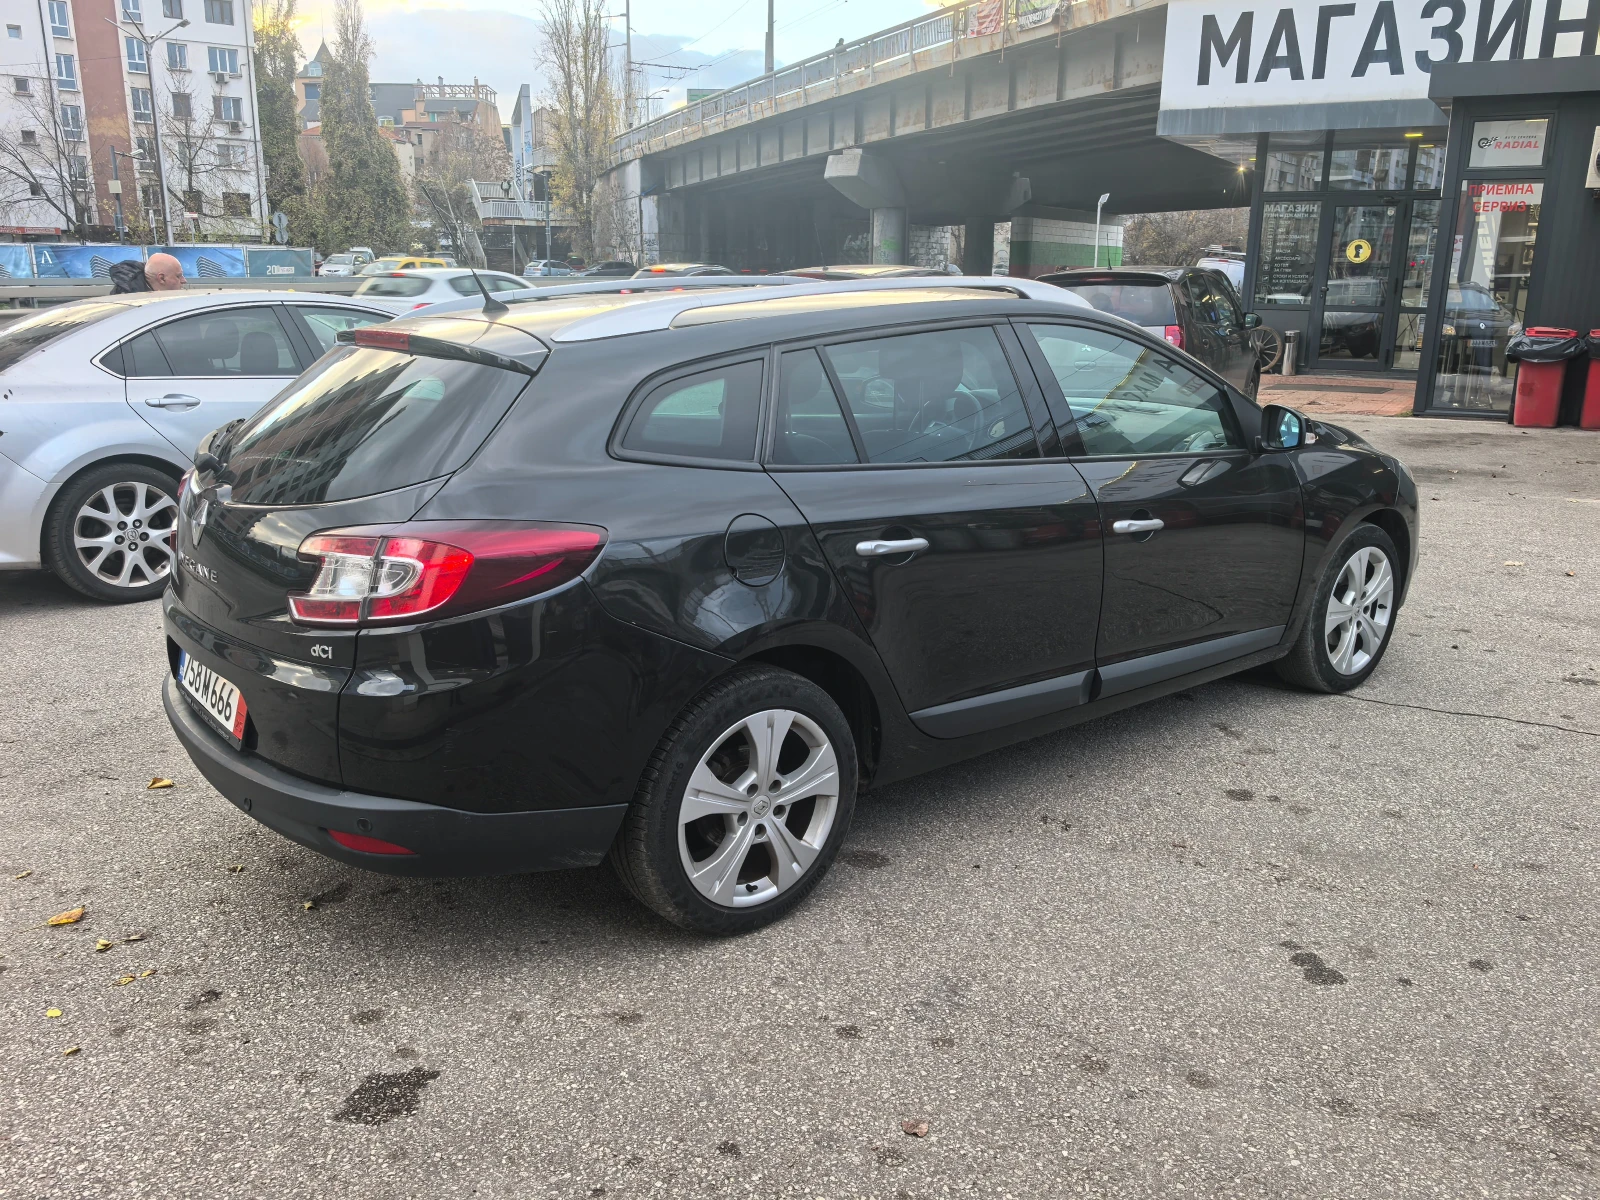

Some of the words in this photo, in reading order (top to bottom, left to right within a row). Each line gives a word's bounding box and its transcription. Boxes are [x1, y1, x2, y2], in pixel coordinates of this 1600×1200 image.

[1197, 0, 1600, 86] МАГАЗИН
[1494, 140, 1540, 149] RADIAL
[1468, 183, 1534, 196] ПРИЕМНА
[1265, 204, 1318, 212] МАГАЗИН
[1472, 200, 1527, 212] СЕРВИЗ
